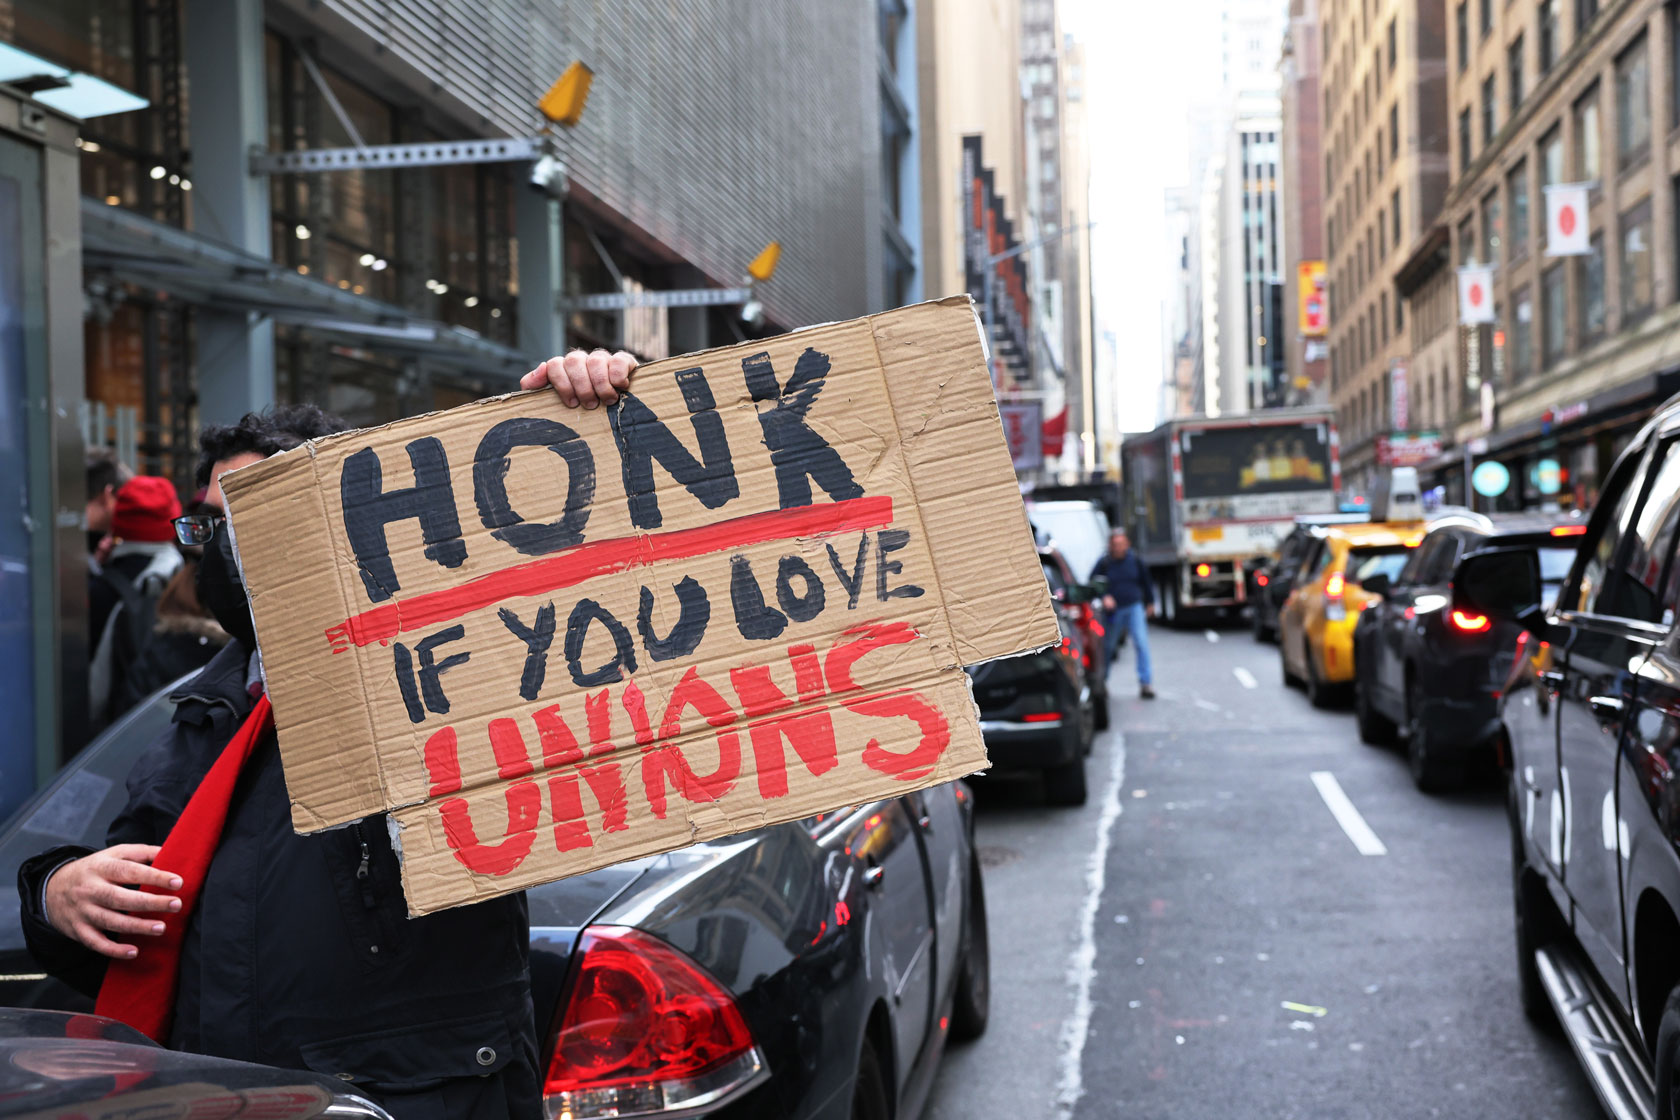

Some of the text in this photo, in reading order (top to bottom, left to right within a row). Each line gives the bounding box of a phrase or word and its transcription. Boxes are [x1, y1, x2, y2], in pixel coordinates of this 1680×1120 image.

[341, 347, 863, 602] HONK
[394, 530, 925, 723] IF YOU LOVE
[423, 623, 950, 875] UNIONS
